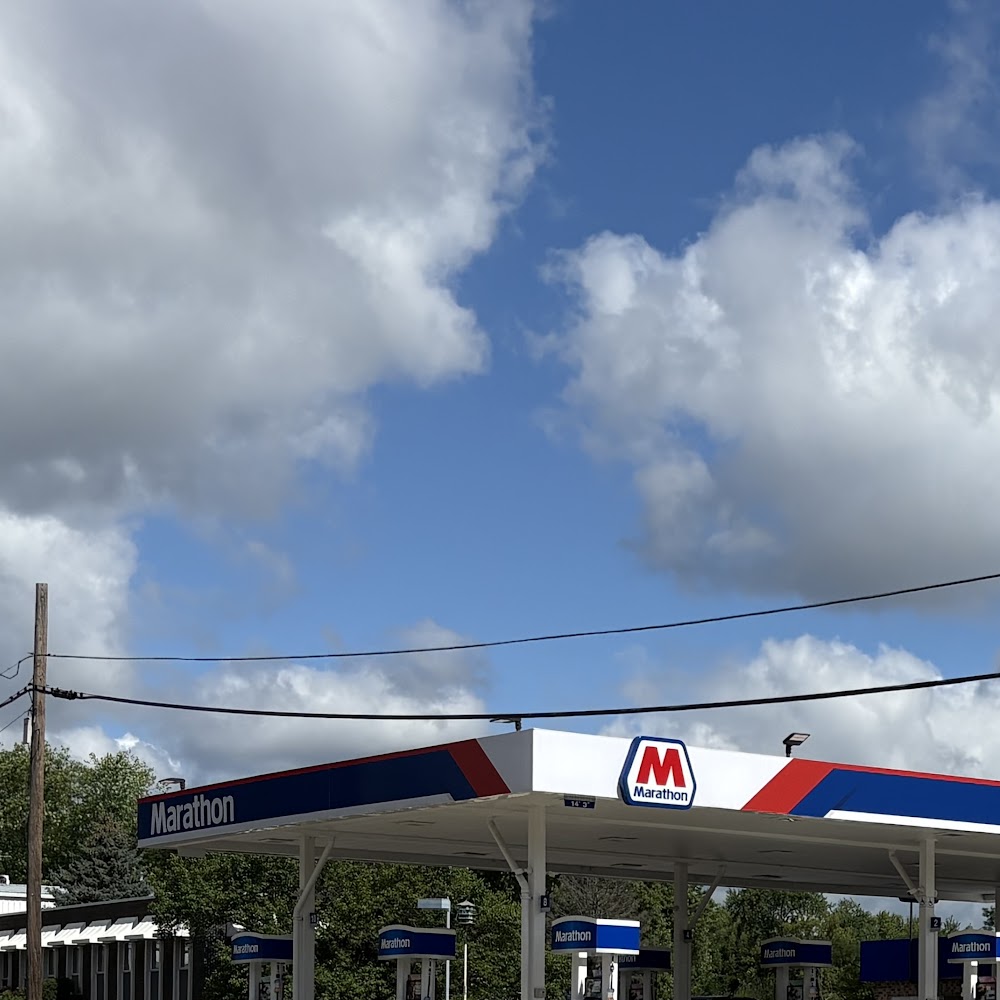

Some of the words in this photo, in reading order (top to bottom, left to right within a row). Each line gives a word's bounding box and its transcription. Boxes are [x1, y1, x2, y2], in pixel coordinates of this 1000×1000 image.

[636, 746, 686, 788] M
[633, 786, 688, 801] Marathon
[150, 794, 235, 836] Marathon
[555, 930, 592, 942] Marathon
[233, 944, 259, 954] Marathon
[381, 937, 411, 949] Marathon
[951, 941, 991, 952] Marathon
[763, 948, 796, 958] Marathon
